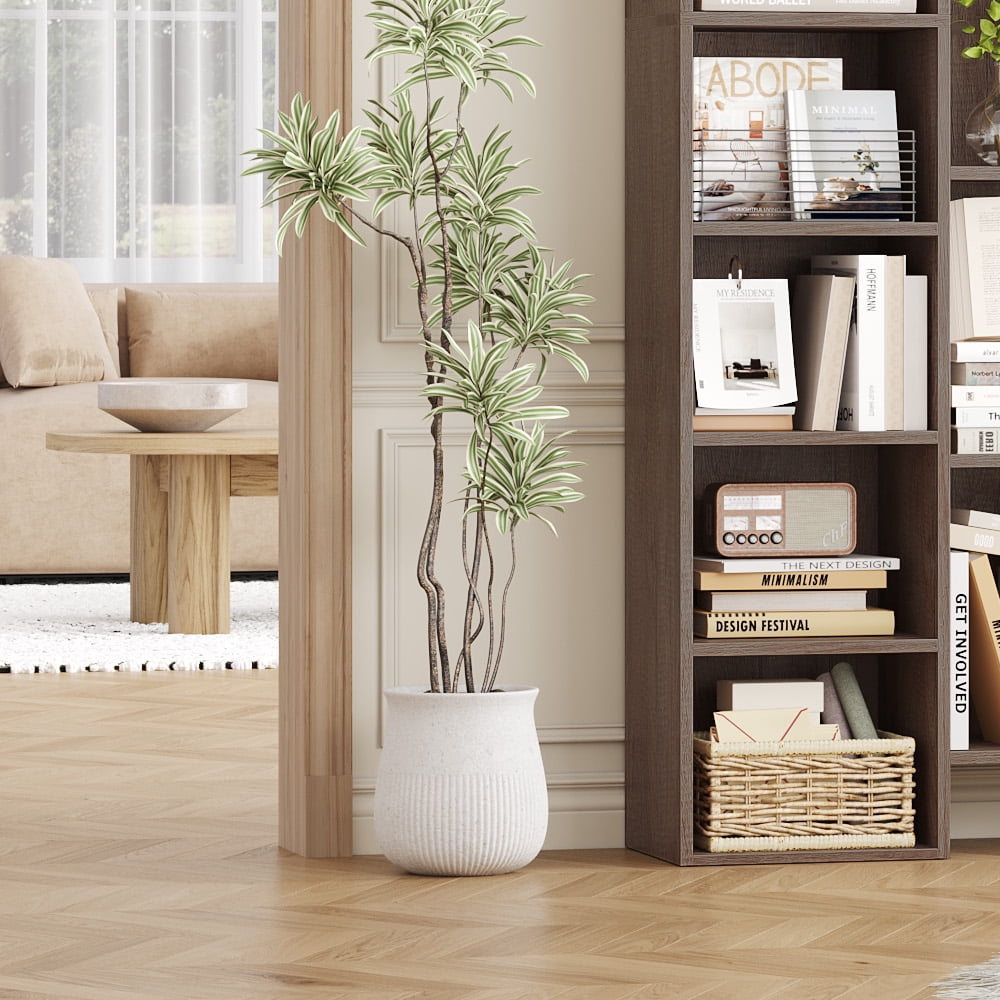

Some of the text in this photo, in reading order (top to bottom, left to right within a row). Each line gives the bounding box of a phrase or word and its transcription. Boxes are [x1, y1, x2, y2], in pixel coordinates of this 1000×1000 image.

[705, 60, 830, 98] ABODE
[811, 105, 878, 115] MINIMAL
[716, 289, 776, 297] MY RESIDENCE
[866, 268, 877, 312] HOFFMANN
[974, 533, 995, 548] GOOD
[782, 560, 892, 570] THE NEXT DESIGN
[761, 574, 829, 587] MINIMALISM
[716, 619, 810, 632] DESIGN FESTIVAL
[955, 593, 967, 714] GET INVOLVED
